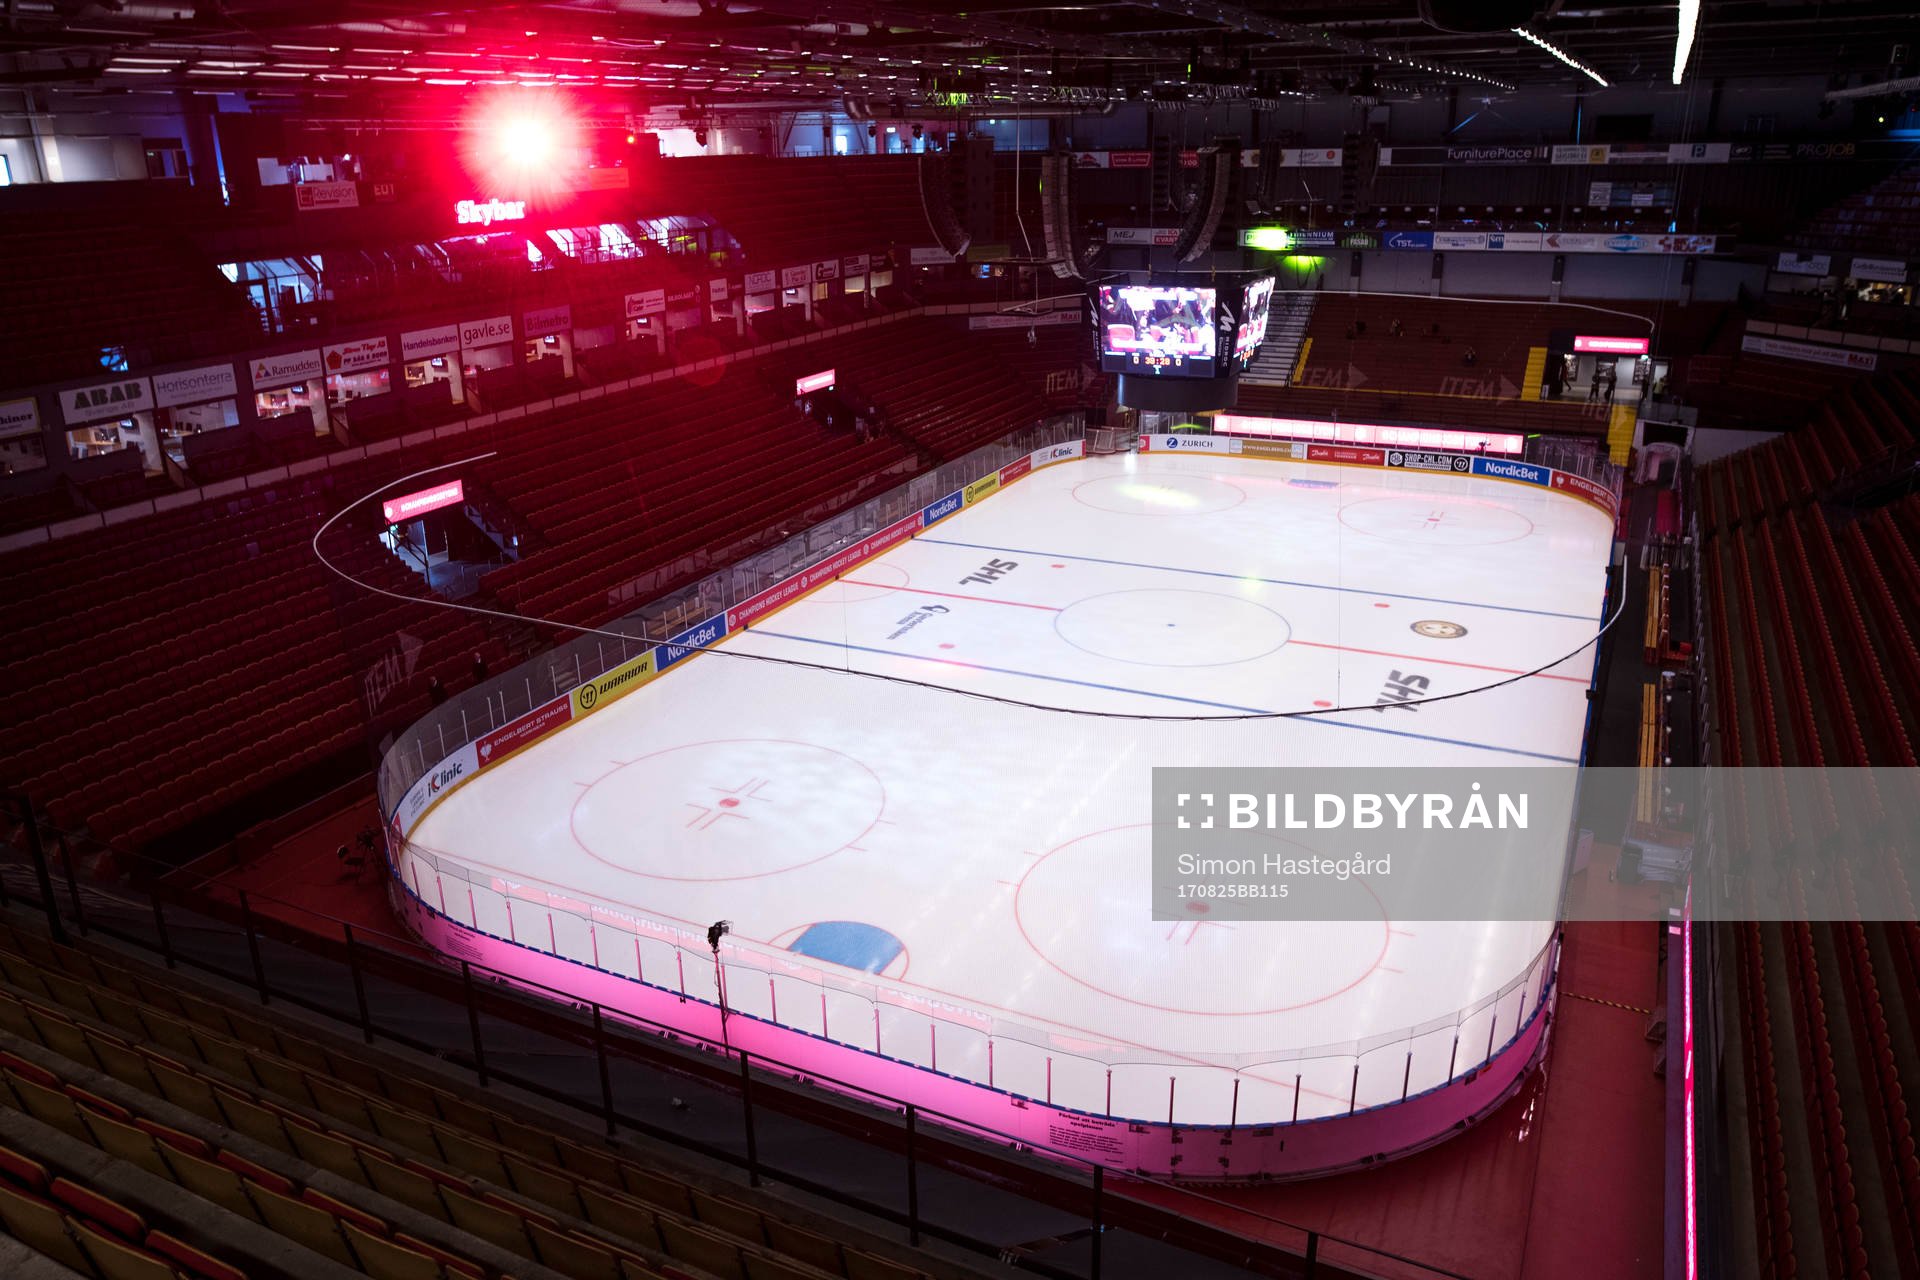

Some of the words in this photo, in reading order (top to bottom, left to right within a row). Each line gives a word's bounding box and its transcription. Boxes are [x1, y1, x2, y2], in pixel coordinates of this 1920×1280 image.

[1448, 148, 1532, 160] FurniturePlace
[456, 198, 526, 226] Skybar
[403, 334, 458, 351] Handelsbanken
[463, 321, 511, 345] gavle.se
[271, 360, 321, 377] Ramudden
[156, 370, 233, 394] Horisonterra
[1046, 367, 1080, 395] ITEM
[1439, 375, 1495, 399] ITEM
[74, 381, 143, 410] ABAB
[1050, 447, 1073, 459] iClinic
[1181, 440, 1213, 448] ZURICH
[1404, 453, 1452, 465] SHOP-CHL.COM
[1485, 462, 1539, 481] NordicBet
[929, 498, 958, 521] NordicBet
[809, 563, 833, 583] CHAMPIONS
[847, 549, 862, 563] LEAGUE
[958, 558, 1019, 586] SHL
[738, 599, 766, 620] CHAMPIONS
[765, 591, 783, 607] HOCKEY
[783, 581, 799, 597] LEAGUE
[599, 661, 648, 695] WARRIOR
[494, 720, 536, 747] ENGELBERT
[536, 703, 569, 725] STRAUSS
[427, 762, 463, 798] iClinic
